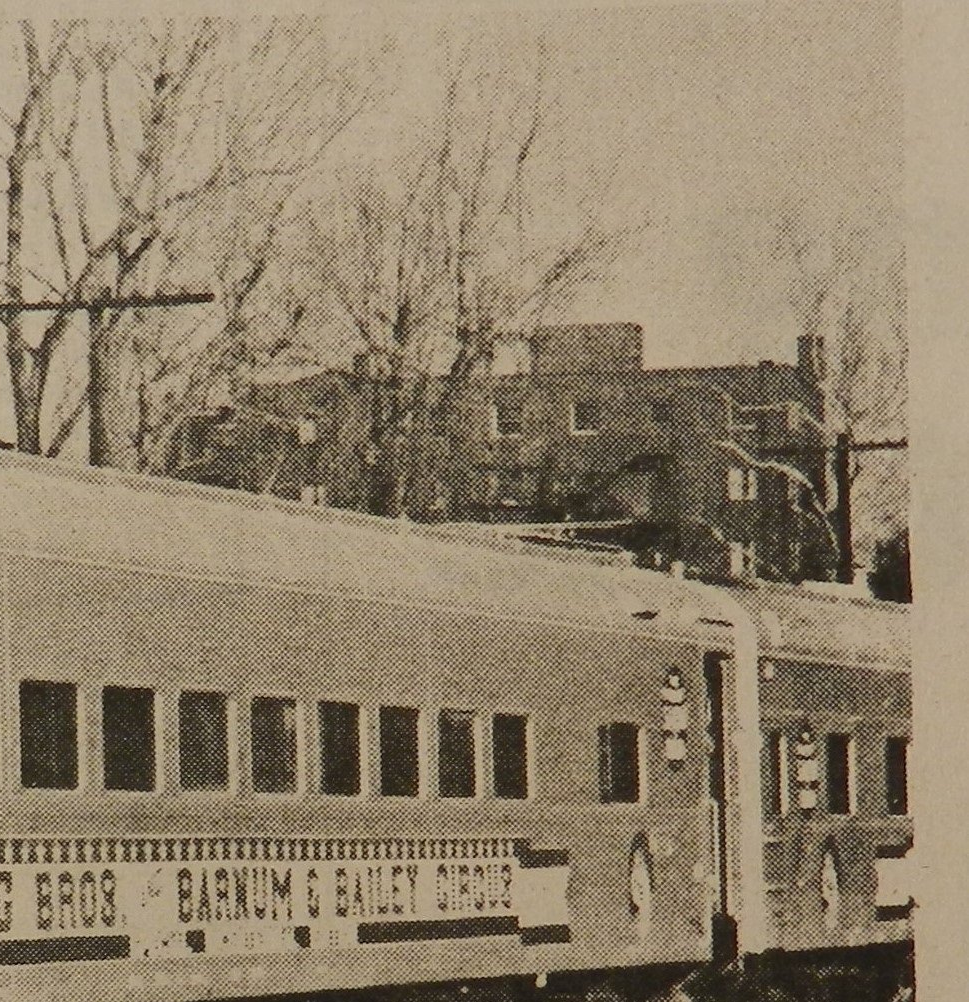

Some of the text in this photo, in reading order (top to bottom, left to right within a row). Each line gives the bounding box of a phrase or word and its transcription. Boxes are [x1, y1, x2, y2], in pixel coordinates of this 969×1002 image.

[176, 865, 292, 923] BARNUM
[334, 862, 418, 919] BAILEY
[436, 862, 512, 912] CIRCUS
